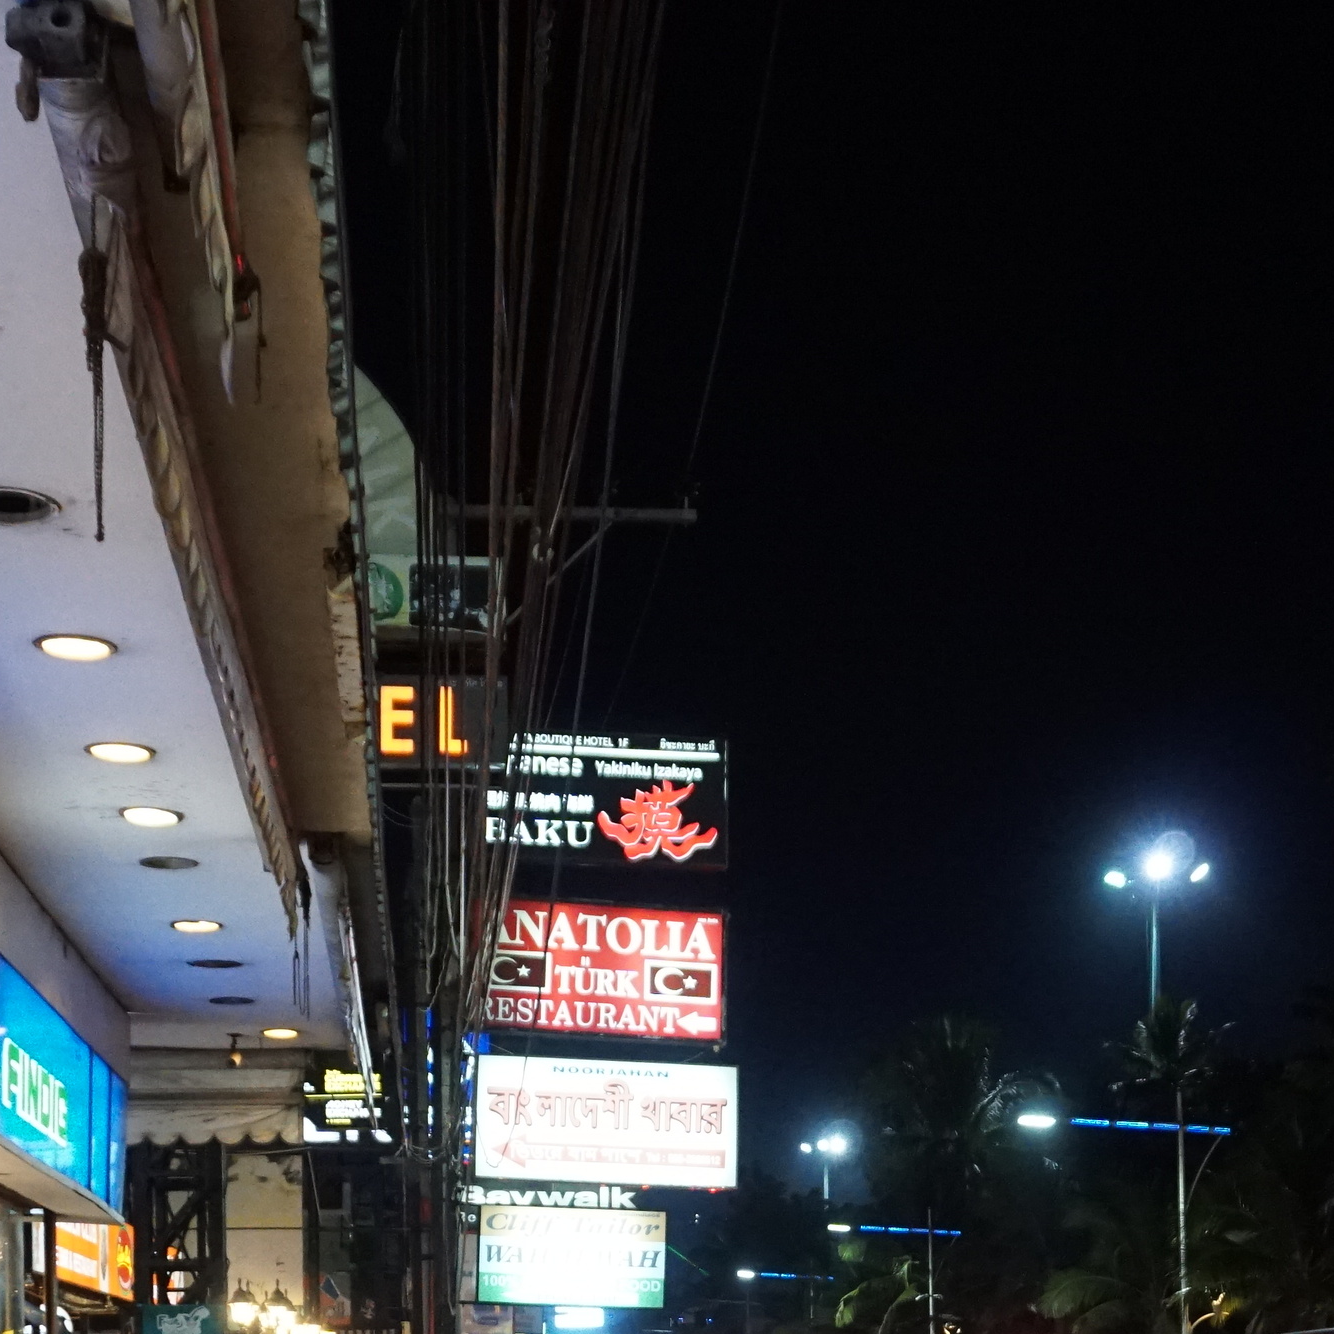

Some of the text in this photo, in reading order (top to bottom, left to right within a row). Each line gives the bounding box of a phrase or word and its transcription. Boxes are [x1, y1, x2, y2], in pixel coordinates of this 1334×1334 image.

[584, 736, 614, 747] HOTEL
[595, 760, 652, 779] Yakiniku
[654, 761, 703, 782] Izakaya
[554, 956, 640, 998] TÜRK
[553, 1065, 670, 1078] NOORJAHAN
